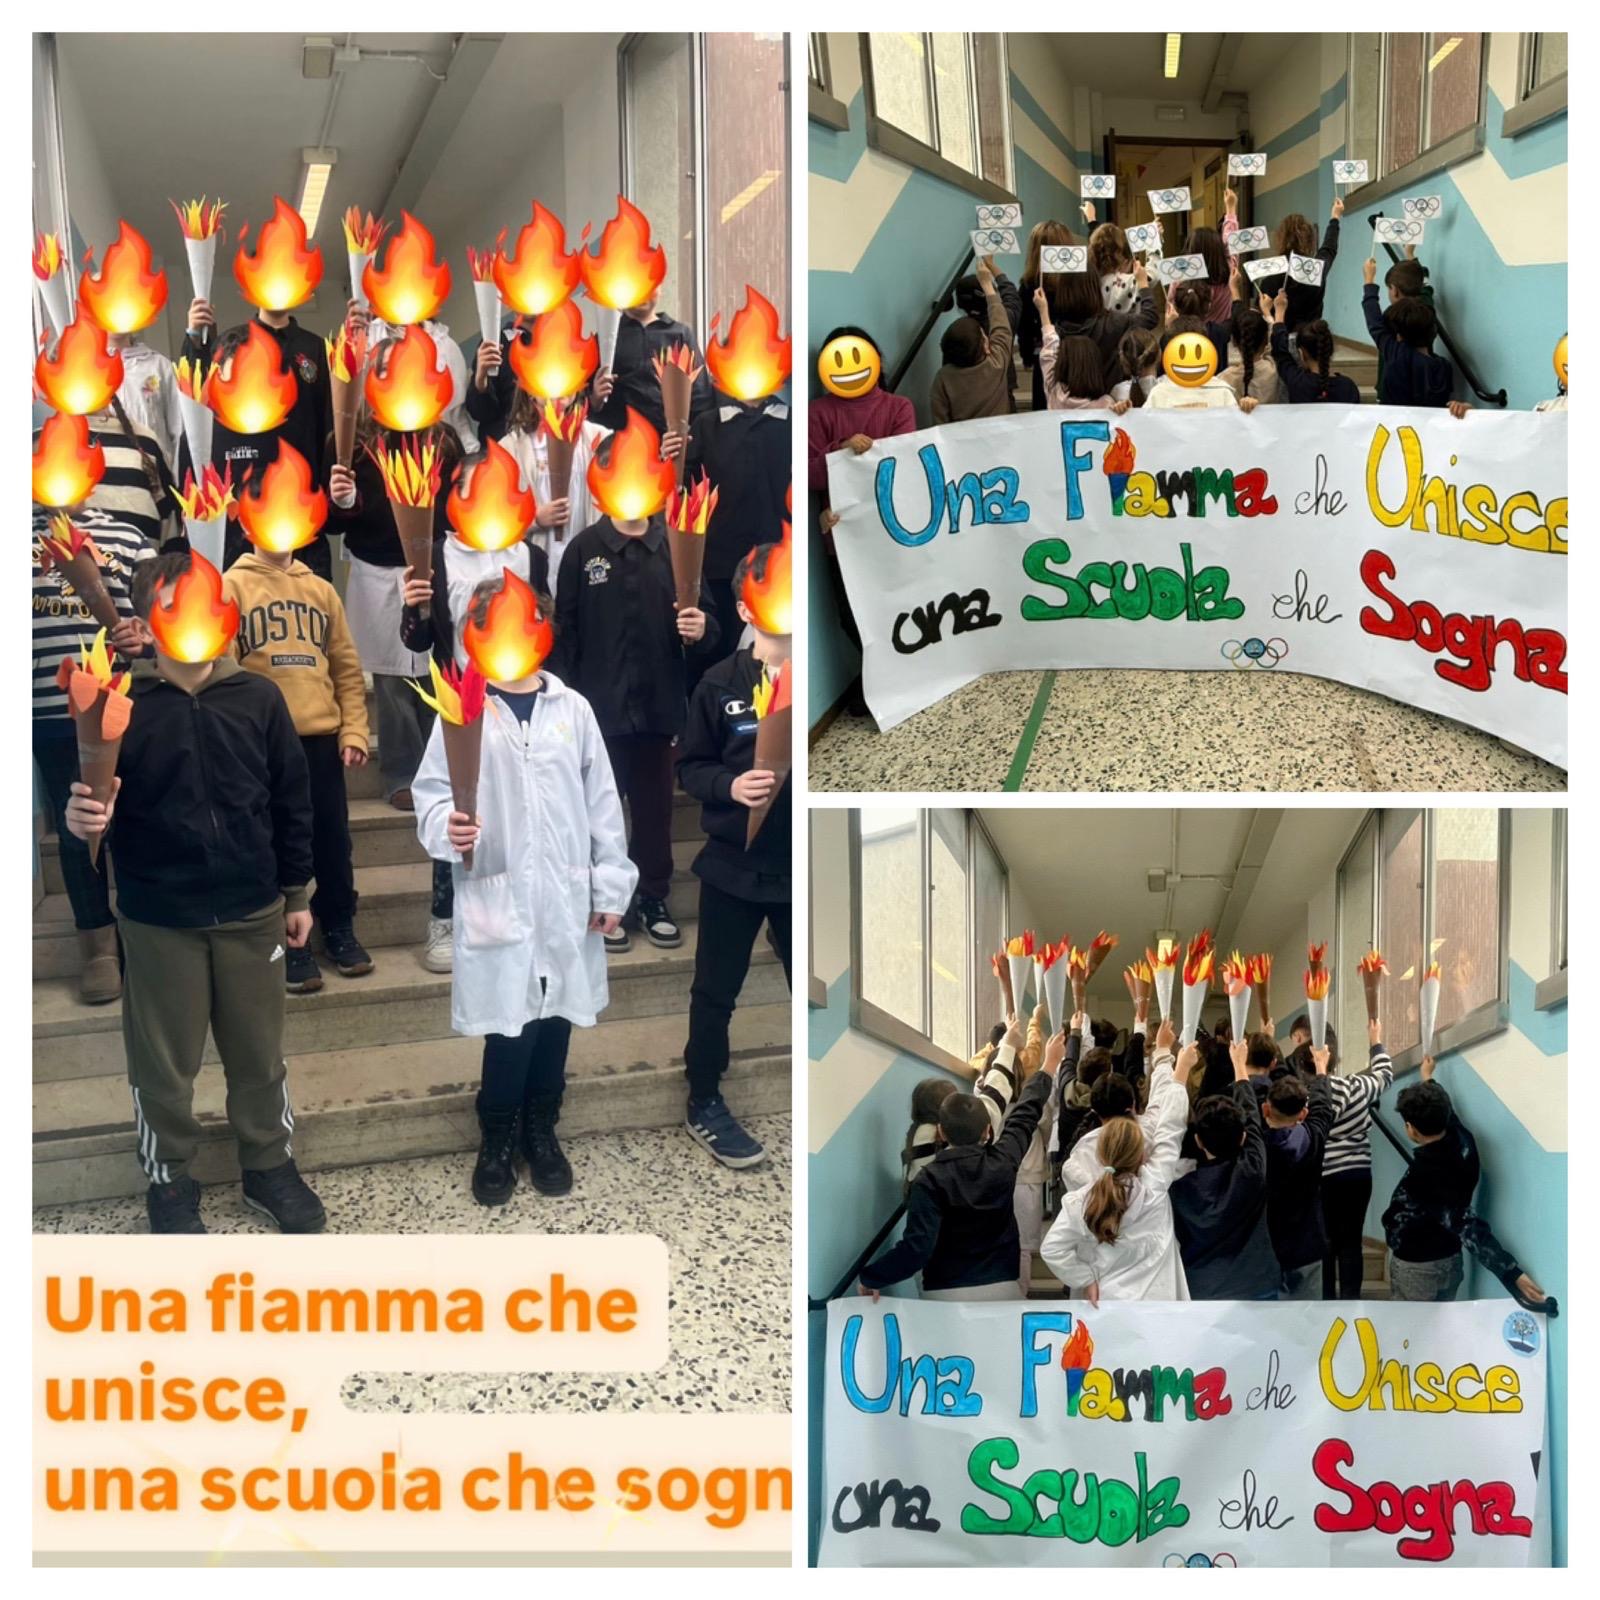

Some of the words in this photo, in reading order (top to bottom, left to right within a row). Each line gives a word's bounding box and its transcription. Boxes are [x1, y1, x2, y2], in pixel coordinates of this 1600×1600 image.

[875, 441, 1031, 548] Una
[1294, 454, 1348, 517] che
[892, 587, 1003, 655] una
[1020, 538, 1246, 622] Scuola
[1272, 568, 1343, 624] che
[1359, 548, 1568, 694] Sogna
[840, 1312, 983, 1418] Una
[1245, 1349, 1297, 1411] che
[1319, 1316, 1525, 1414] Unisce
[832, 1478, 941, 1534] una
[960, 1437, 1191, 1547] Scuola
[1219, 1468, 1295, 1532] che
[1312, 1438, 1533, 1562] Sogna
